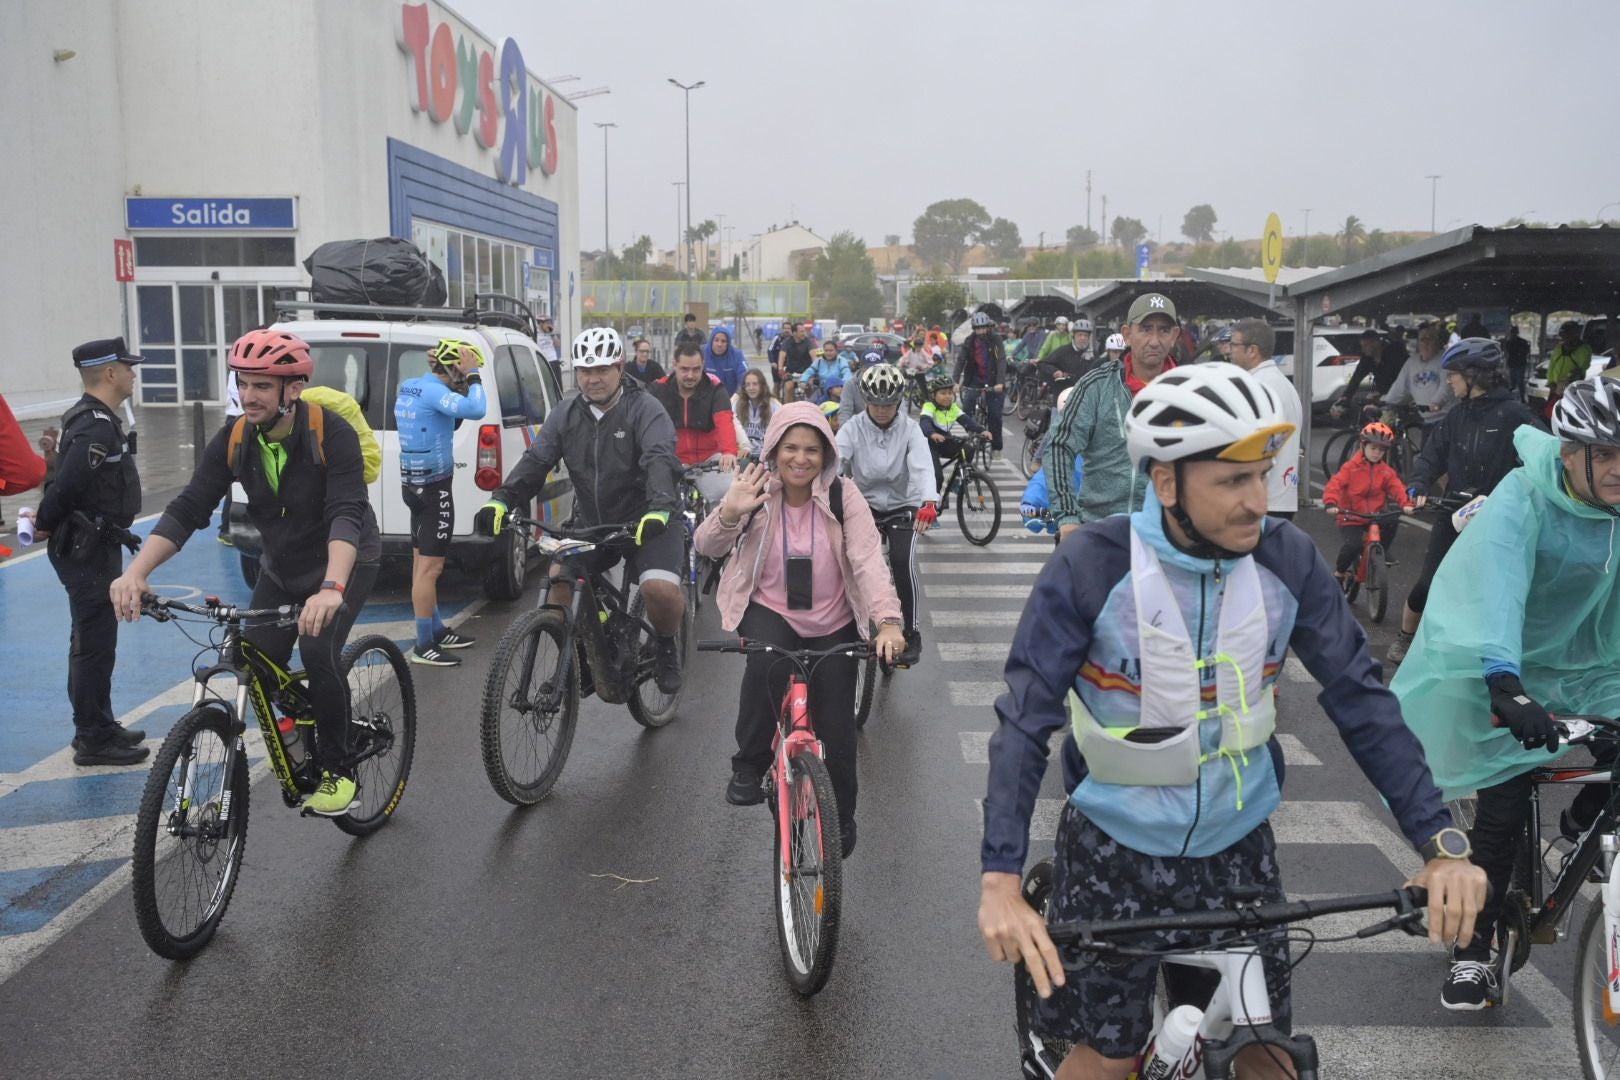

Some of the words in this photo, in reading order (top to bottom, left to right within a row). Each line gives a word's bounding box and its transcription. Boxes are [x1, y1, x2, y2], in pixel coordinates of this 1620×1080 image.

[400, 2, 498, 149] TOYS
[528, 84, 558, 176] US
[171, 203, 250, 225] Salida
[1267, 230, 1277, 266] C
[1150, 296, 1164, 308] NY
[436, 490, 450, 540] ASFAS
